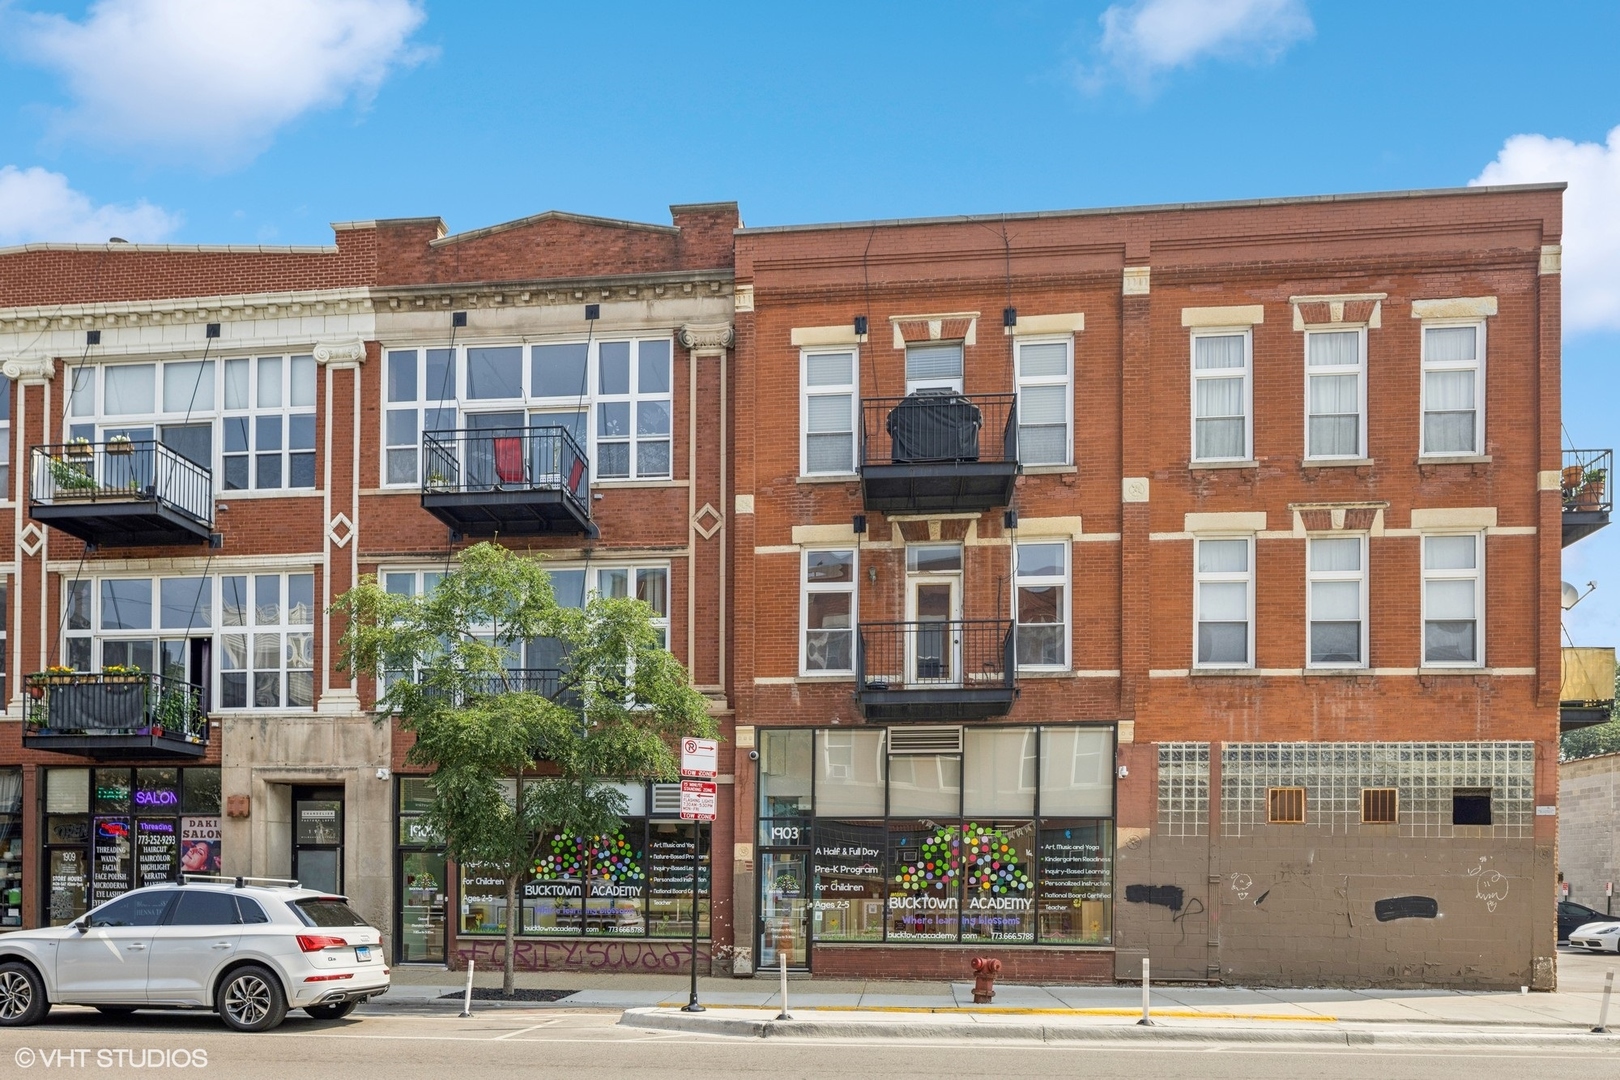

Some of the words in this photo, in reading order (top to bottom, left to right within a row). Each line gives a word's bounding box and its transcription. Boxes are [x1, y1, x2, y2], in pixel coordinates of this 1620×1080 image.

[136, 791, 178, 804] SALON
[139, 822, 173, 832] Threading
[182, 829, 222, 839] SALON
[771, 827, 799, 840] 1903
[138, 835, 176, 845] 773-252-9293
[96, 846, 127, 854] THREADING
[862, 848, 879, 857] Day
[63, 852, 76, 861] 1909
[815, 865, 839, 873] Pre-K
[840, 865, 878, 875] Program
[476, 877, 504, 885] Children
[525, 885, 581, 896] BUCKTOWN
[591, 886, 642, 896] ACADEMY
[815, 883, 828, 891] for
[830, 883, 864, 891] Children
[463, 894, 480, 903] Ages
[890, 897, 957, 909] BUCKTOWN
[969, 898, 1032, 910] ACADEMY
[815, 901, 835, 910] Ages
[902, 914, 933, 924] Where
[978, 915, 1020, 924] blossoms
[991, 932, 1034, 940] 773.666.5788
